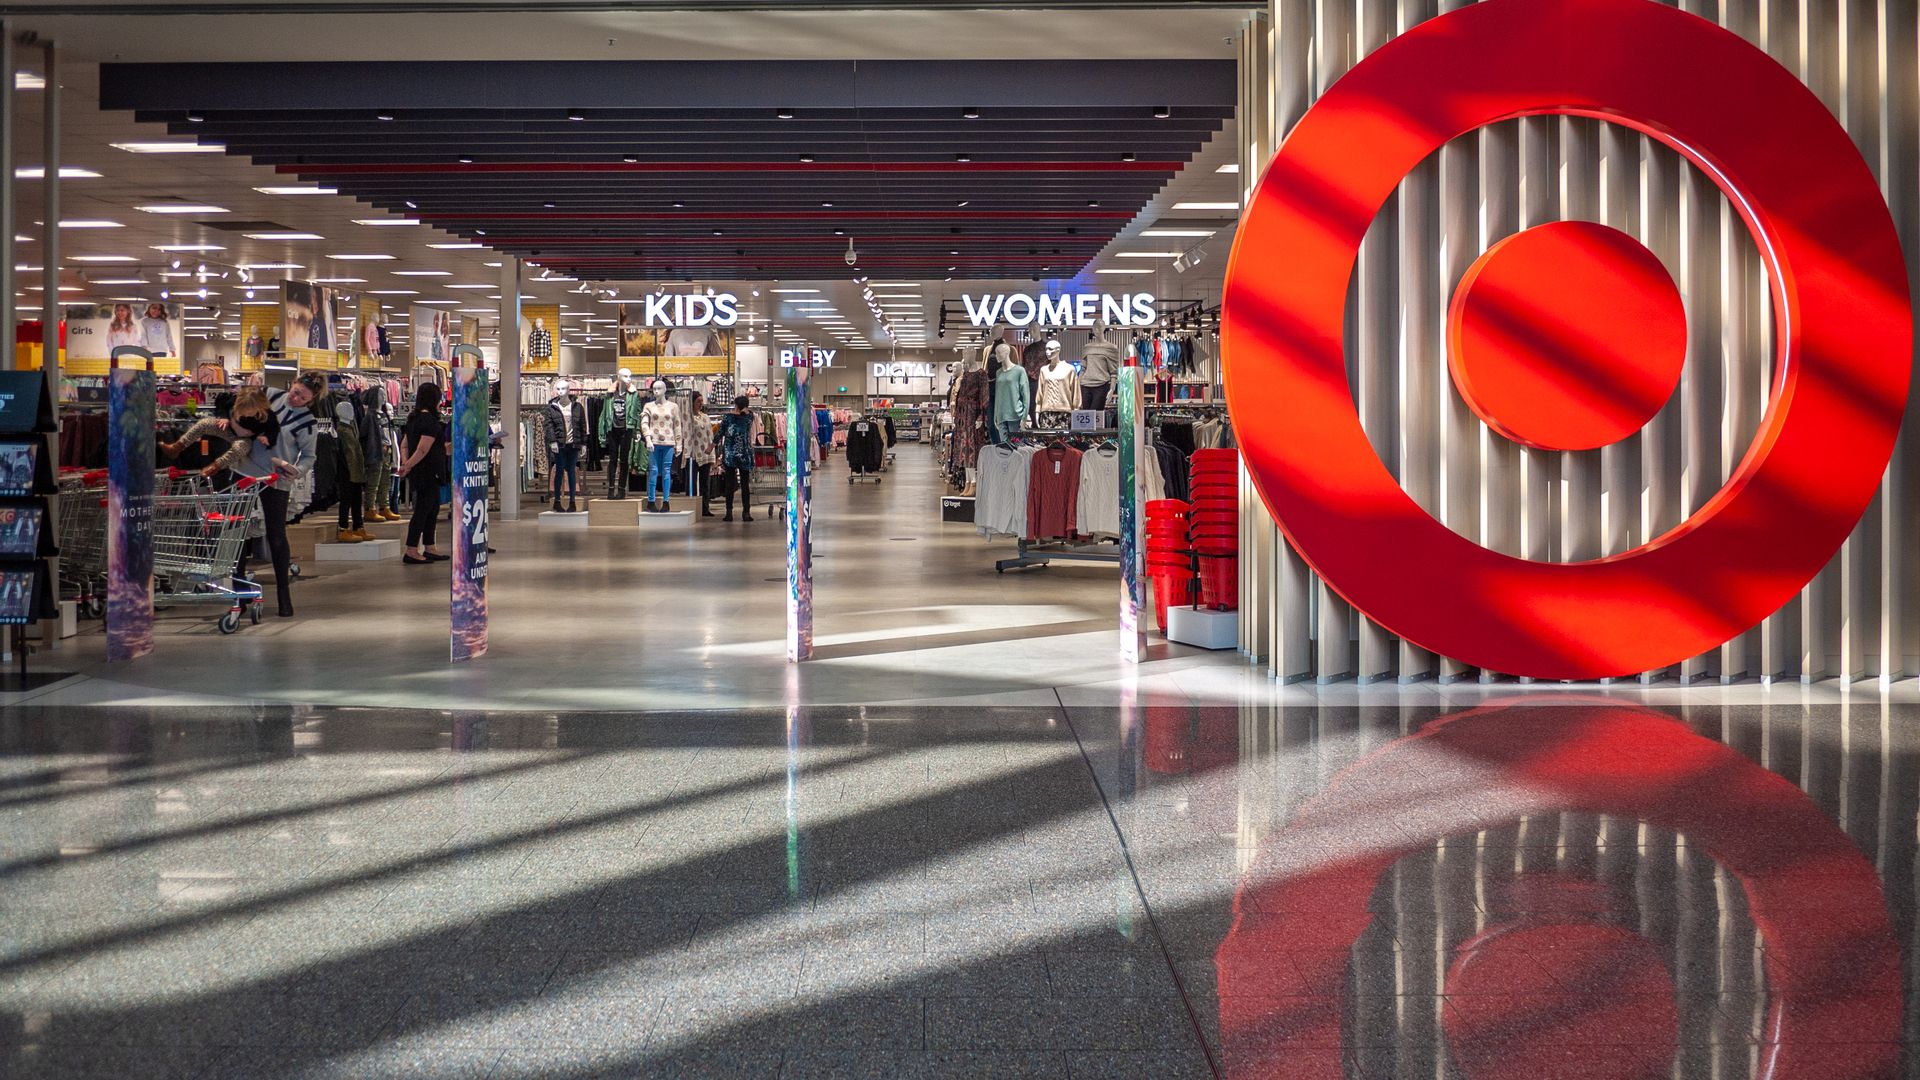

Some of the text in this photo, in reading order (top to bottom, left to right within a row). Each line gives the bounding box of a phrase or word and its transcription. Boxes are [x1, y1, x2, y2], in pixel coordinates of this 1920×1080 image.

[645, 293, 738, 327] KIDS
[962, 293, 1156, 327] WOMENS
[71, 327, 94, 336] Girls
[780, 350, 837, 368] BBY
[873, 363, 936, 377] DIGITAL
[1076, 414, 1091, 424] $25
[477, 447, 486, 458] ALL
[120, 506, 154, 518] MOTHE
[471, 565, 488, 580] UNDE
